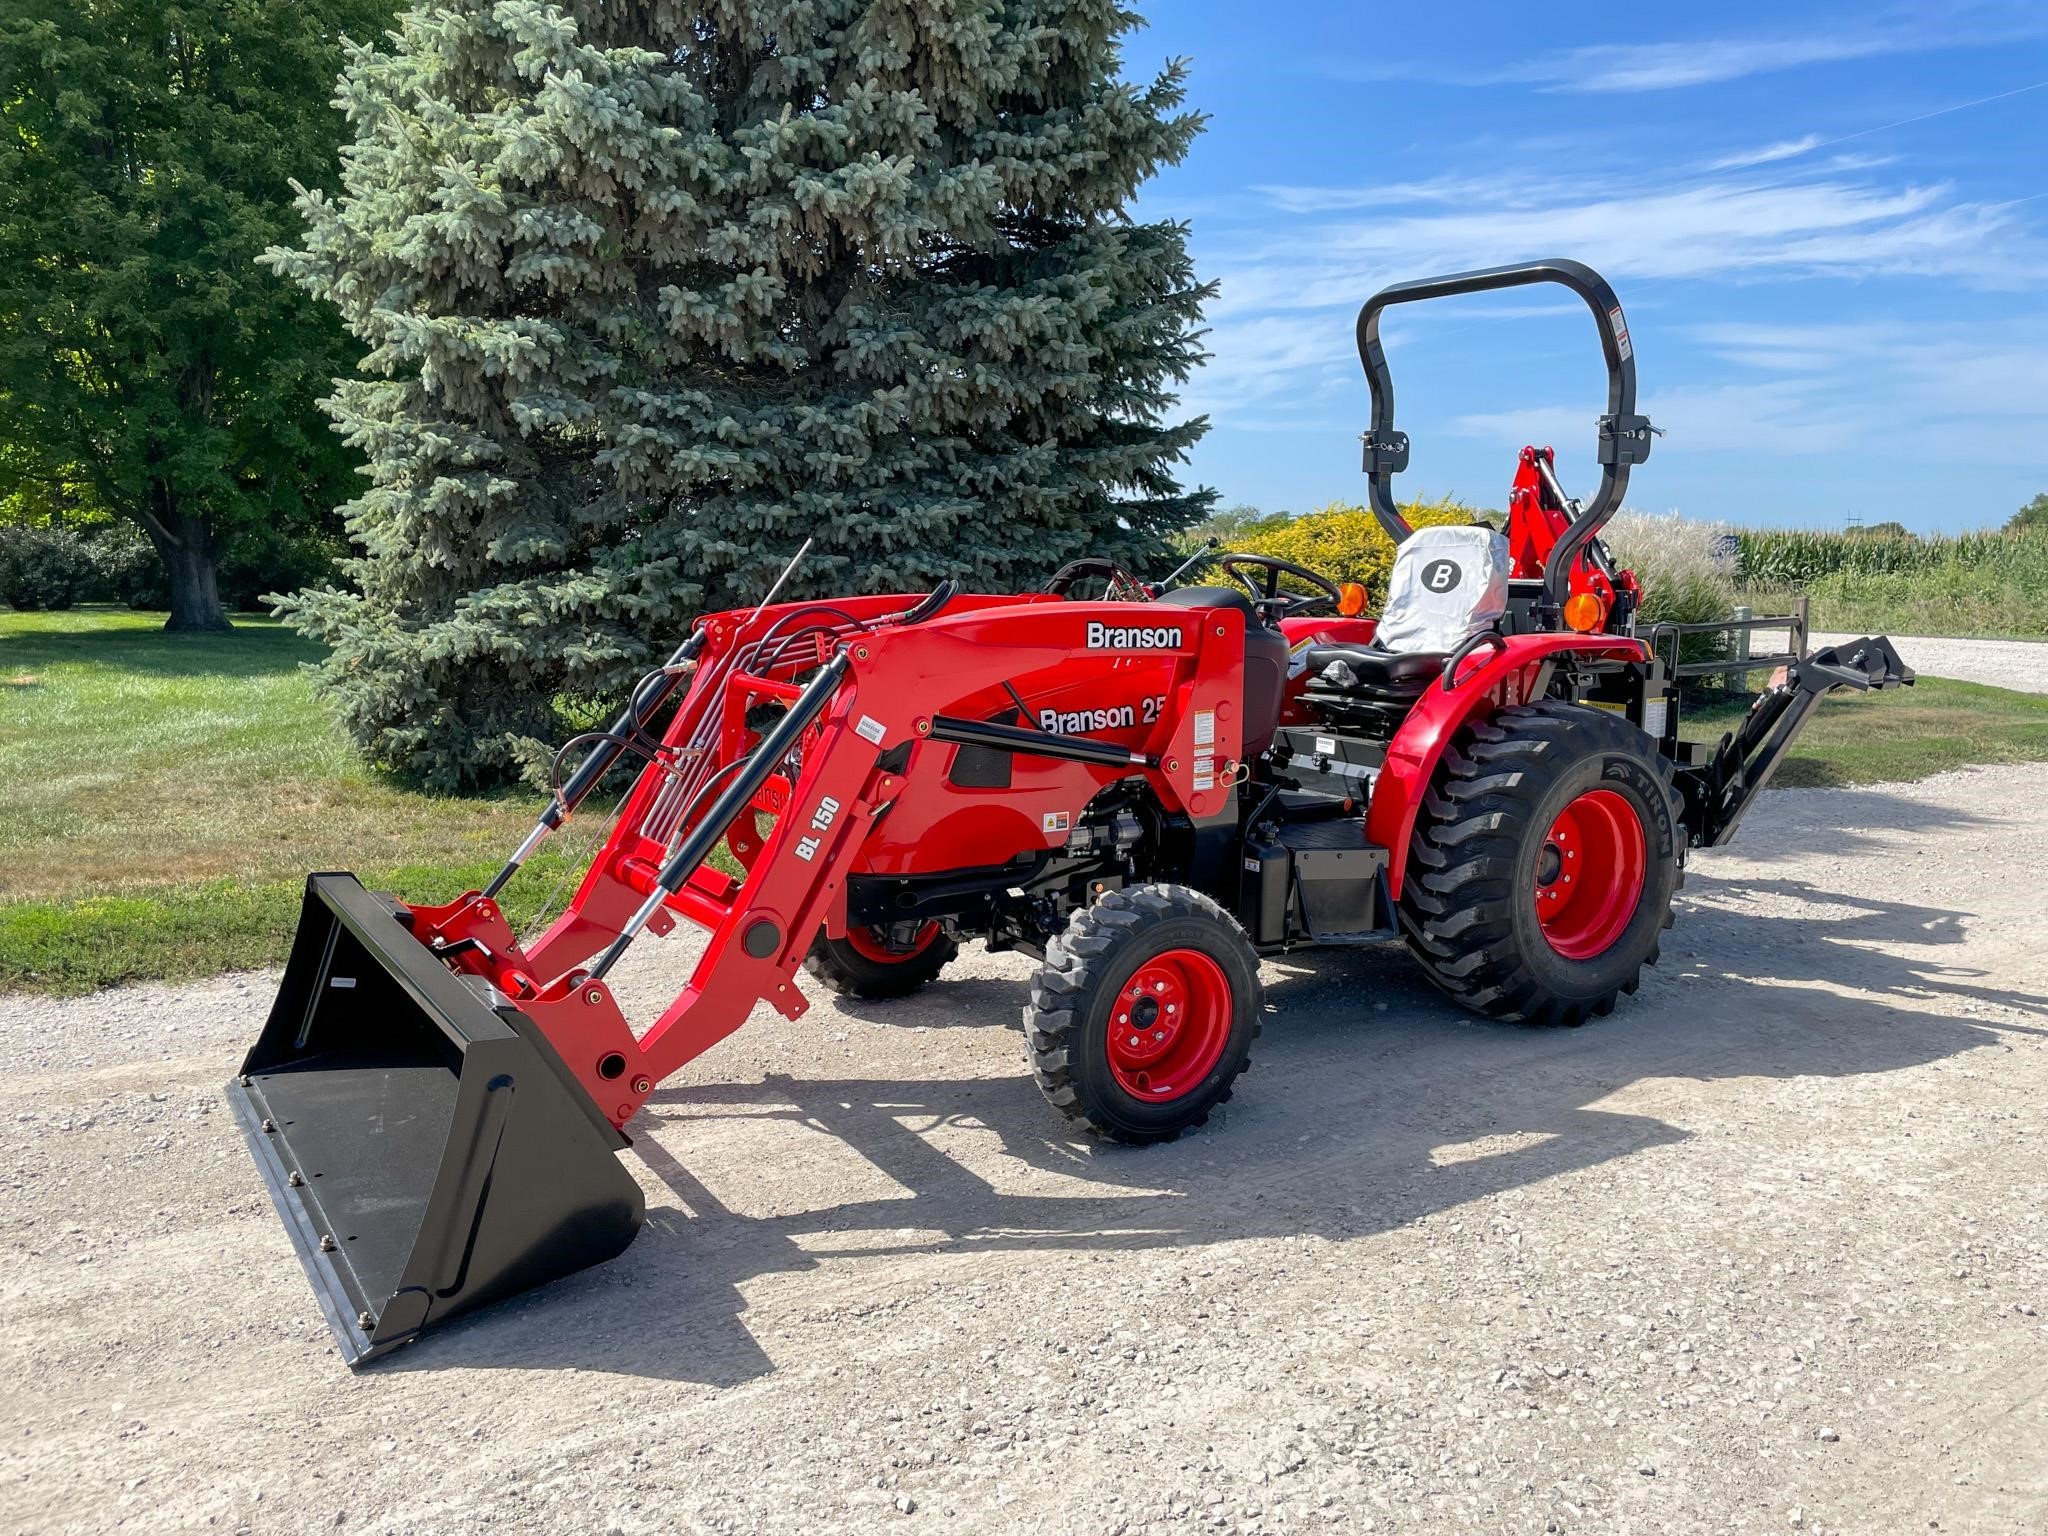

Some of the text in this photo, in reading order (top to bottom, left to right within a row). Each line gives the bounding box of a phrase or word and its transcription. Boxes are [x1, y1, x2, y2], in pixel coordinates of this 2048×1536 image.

[1431, 564, 1453, 588] B
[1087, 622, 1182, 648] Branson
[1040, 705, 1134, 734] Branson
[1637, 773, 1671, 854] TIRON
[793, 795, 840, 862] BL 150
